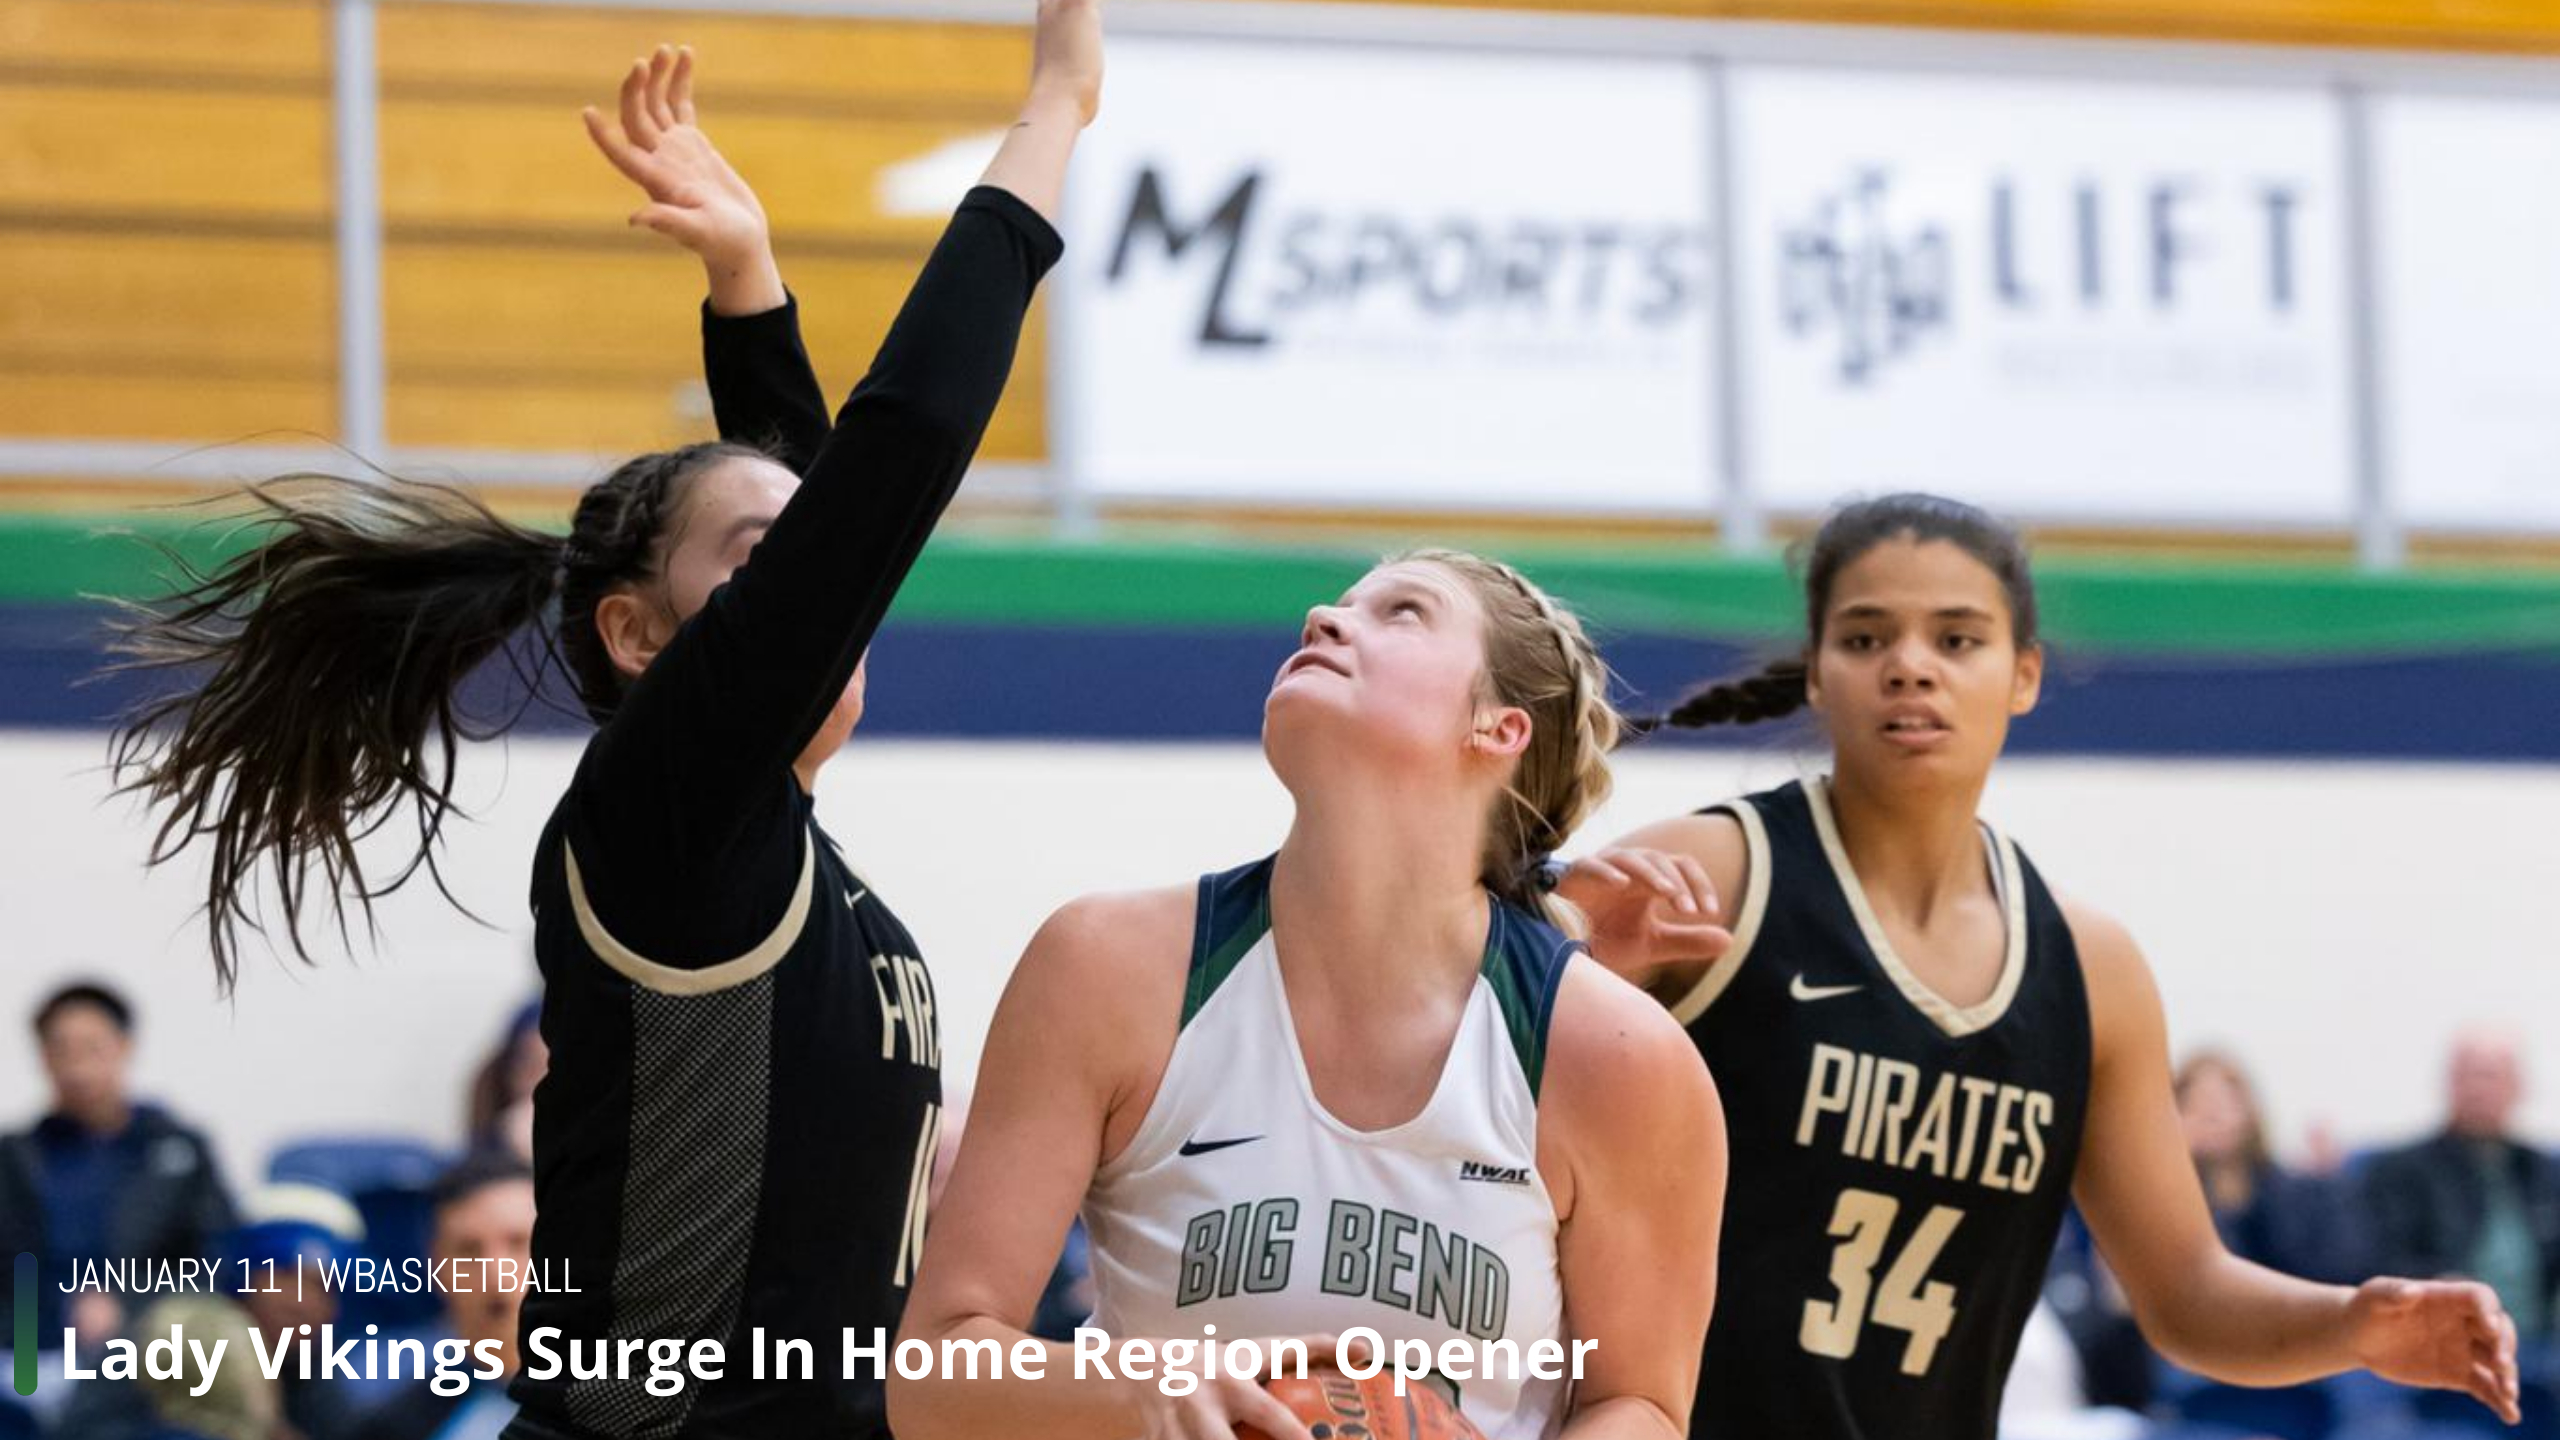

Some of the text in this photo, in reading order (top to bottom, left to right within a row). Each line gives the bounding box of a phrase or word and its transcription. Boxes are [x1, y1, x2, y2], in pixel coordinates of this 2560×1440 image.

[1270, 208, 1706, 324] SPORTS
[1992, 178, 2306, 307] LIFT
[1459, 1160, 1531, 1185] NWAC
[1796, 1042, 2053, 1194] PIRATES
[1176, 1198, 1509, 1343] BIG BEND
[1799, 1188, 1965, 1377] 34
